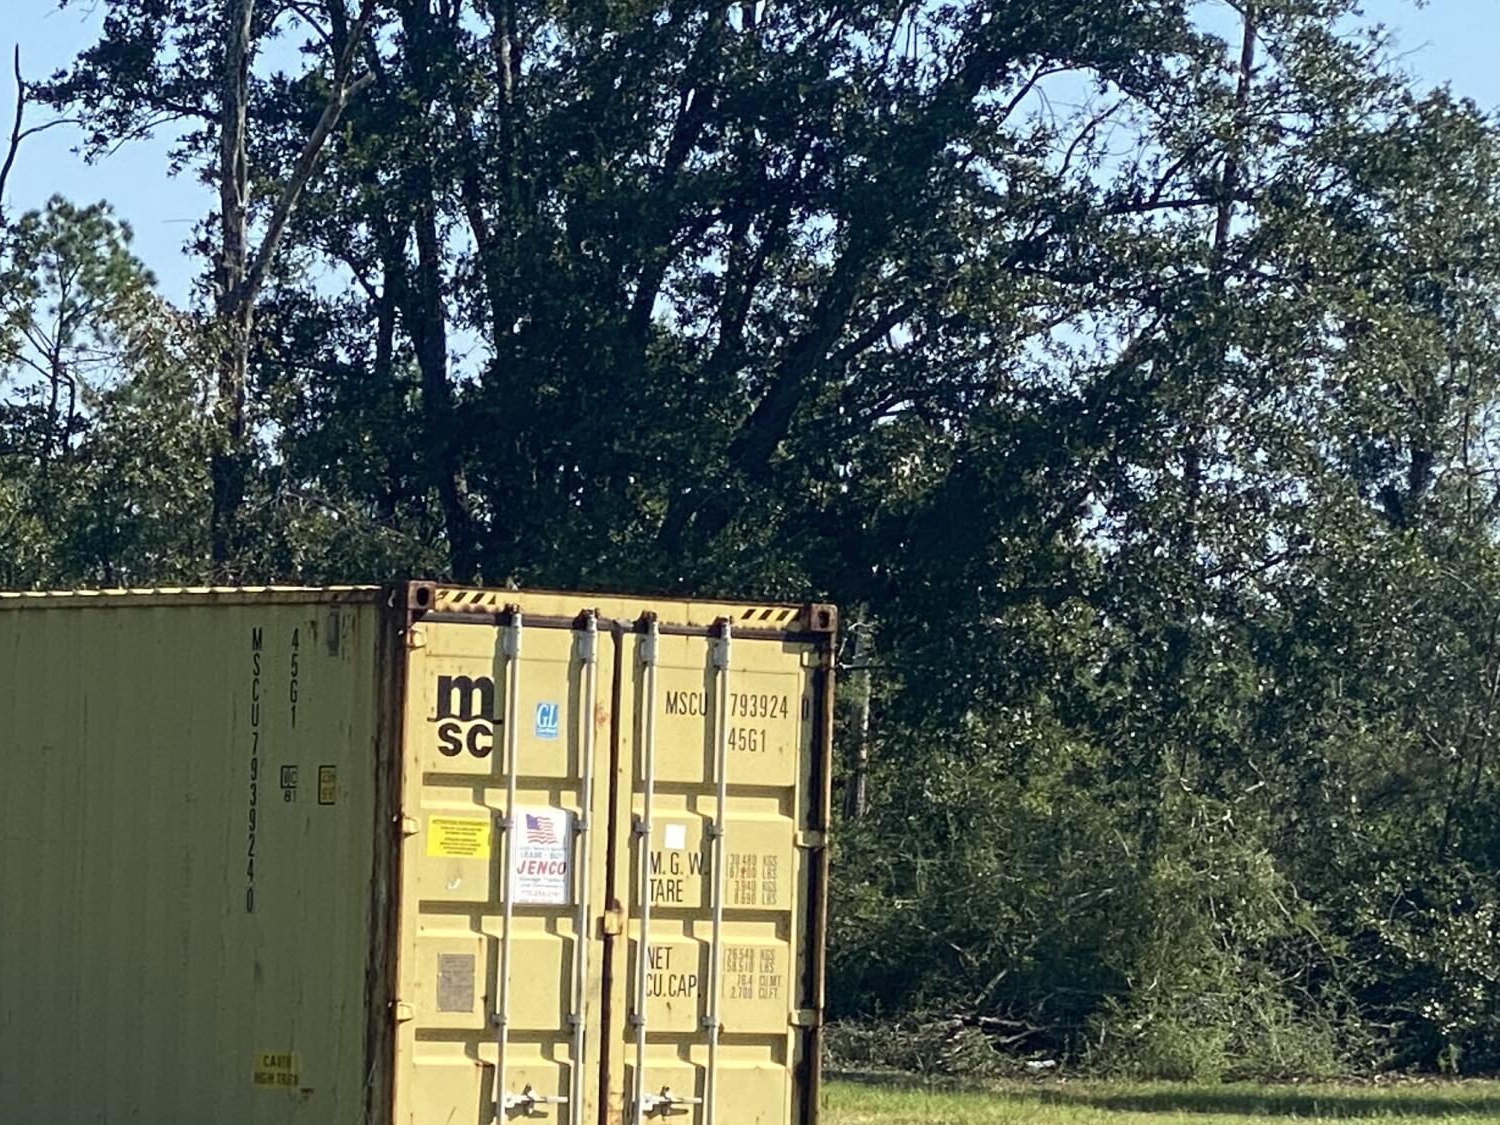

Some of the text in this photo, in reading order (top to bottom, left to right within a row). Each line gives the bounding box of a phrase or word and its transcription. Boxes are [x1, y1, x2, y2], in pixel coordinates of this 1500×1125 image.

[289, 627, 299, 729] 45G1
[665, 690, 708, 717] MSCU
[730, 693, 789, 719] 793924
[727, 727, 767, 753] 45G1
[516, 860, 567, 876] JENCO
[650, 879, 683, 902] TARE
[648, 946, 673, 970] NET
